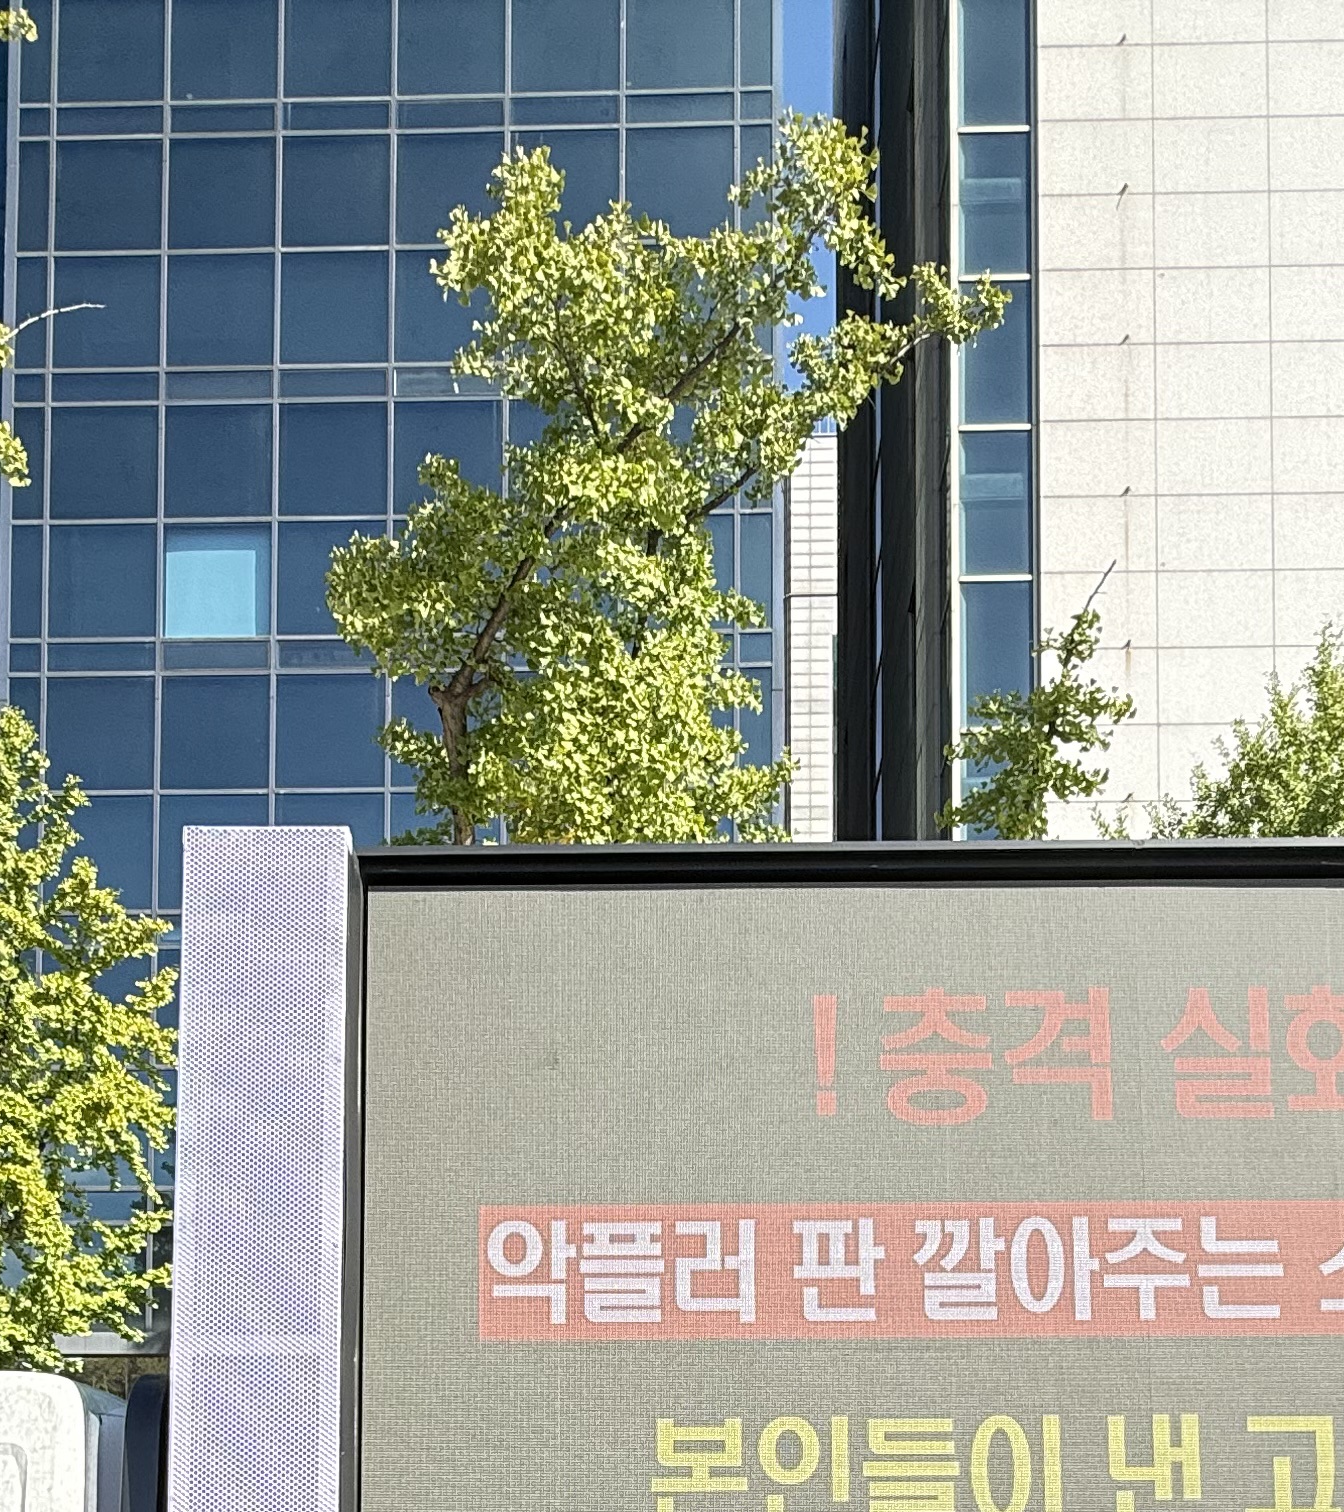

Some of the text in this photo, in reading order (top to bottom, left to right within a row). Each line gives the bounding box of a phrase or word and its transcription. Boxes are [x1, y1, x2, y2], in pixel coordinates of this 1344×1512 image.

[879, 986, 1114, 1127] 충격
[486, 1218, 757, 1325] 악플러
[792, 1216, 886, 1322] 판
[913, 1213, 1285, 1322] 깔아주는
